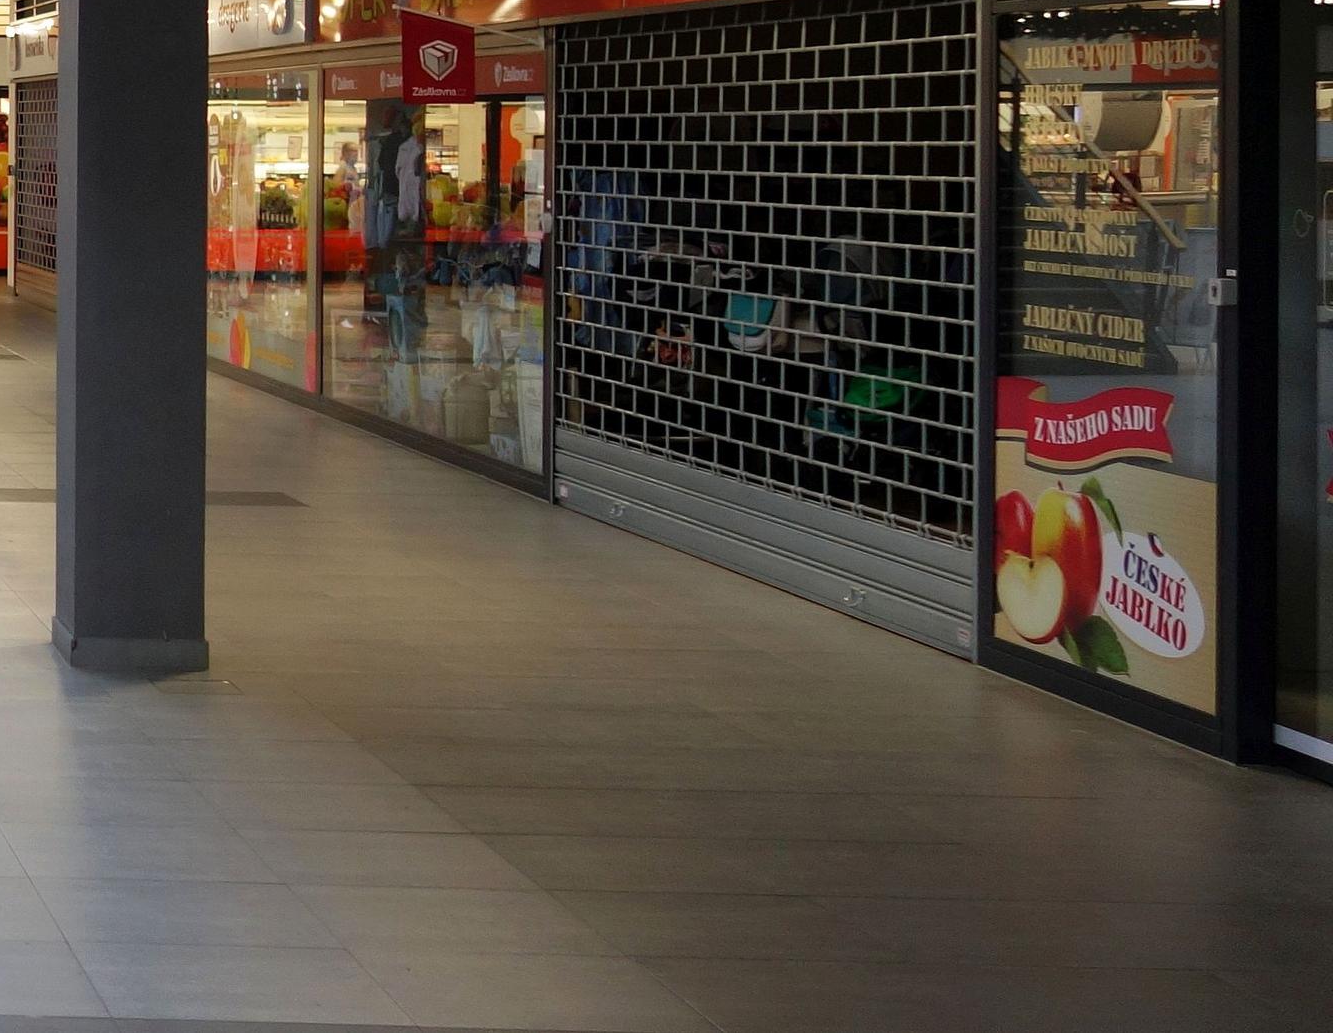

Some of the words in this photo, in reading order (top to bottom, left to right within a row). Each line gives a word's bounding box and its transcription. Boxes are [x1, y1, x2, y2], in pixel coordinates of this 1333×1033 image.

[1022, 303, 1096, 336] JABLEČNÝ
[1097, 313, 1147, 344] CIDER
[1034, 416, 1045, 442] Z
[1045, 409, 1108, 446] NAŠEHO
[1111, 405, 1158, 433] SADU
[1123, 542, 1187, 614] ČESKÉ
[1105, 575, 1188, 652] JABLKO
